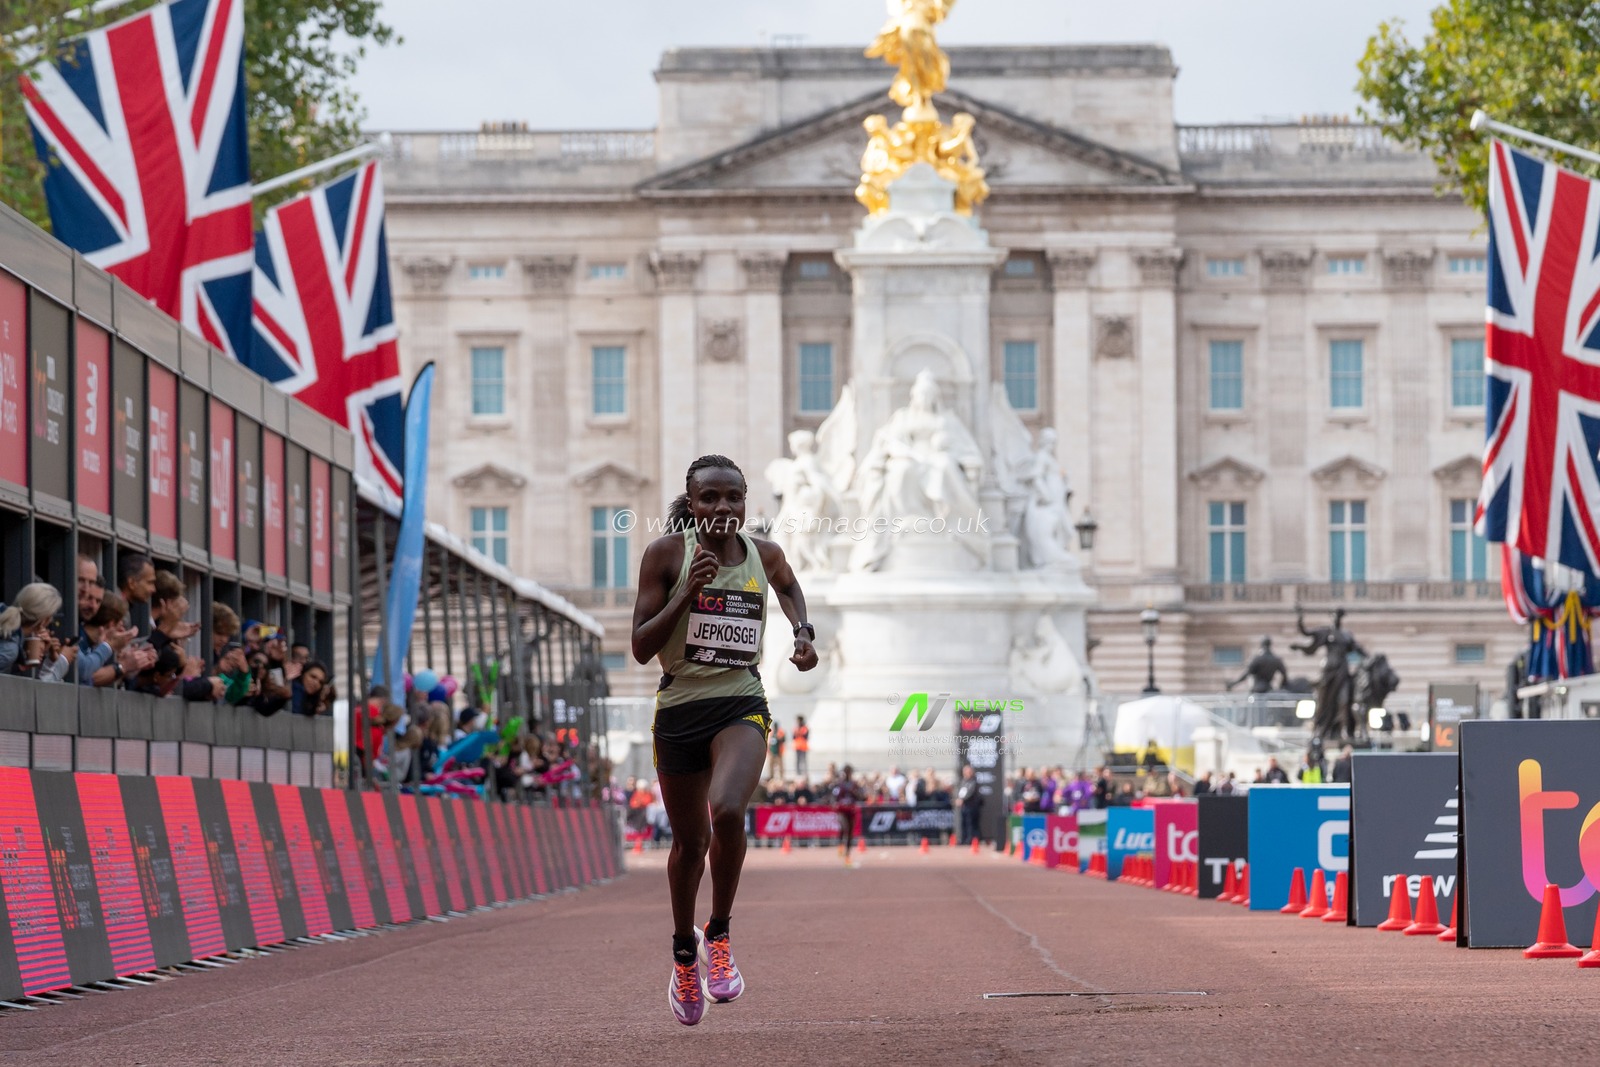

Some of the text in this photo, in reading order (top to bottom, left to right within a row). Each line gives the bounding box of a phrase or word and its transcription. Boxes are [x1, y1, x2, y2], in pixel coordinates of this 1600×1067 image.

[698, 592, 723, 611] tcs
[725, 601, 760, 610] CONSULTANCY
[693, 622, 757, 645] JEPKOSGEI
[729, 658, 750, 666] balanc
